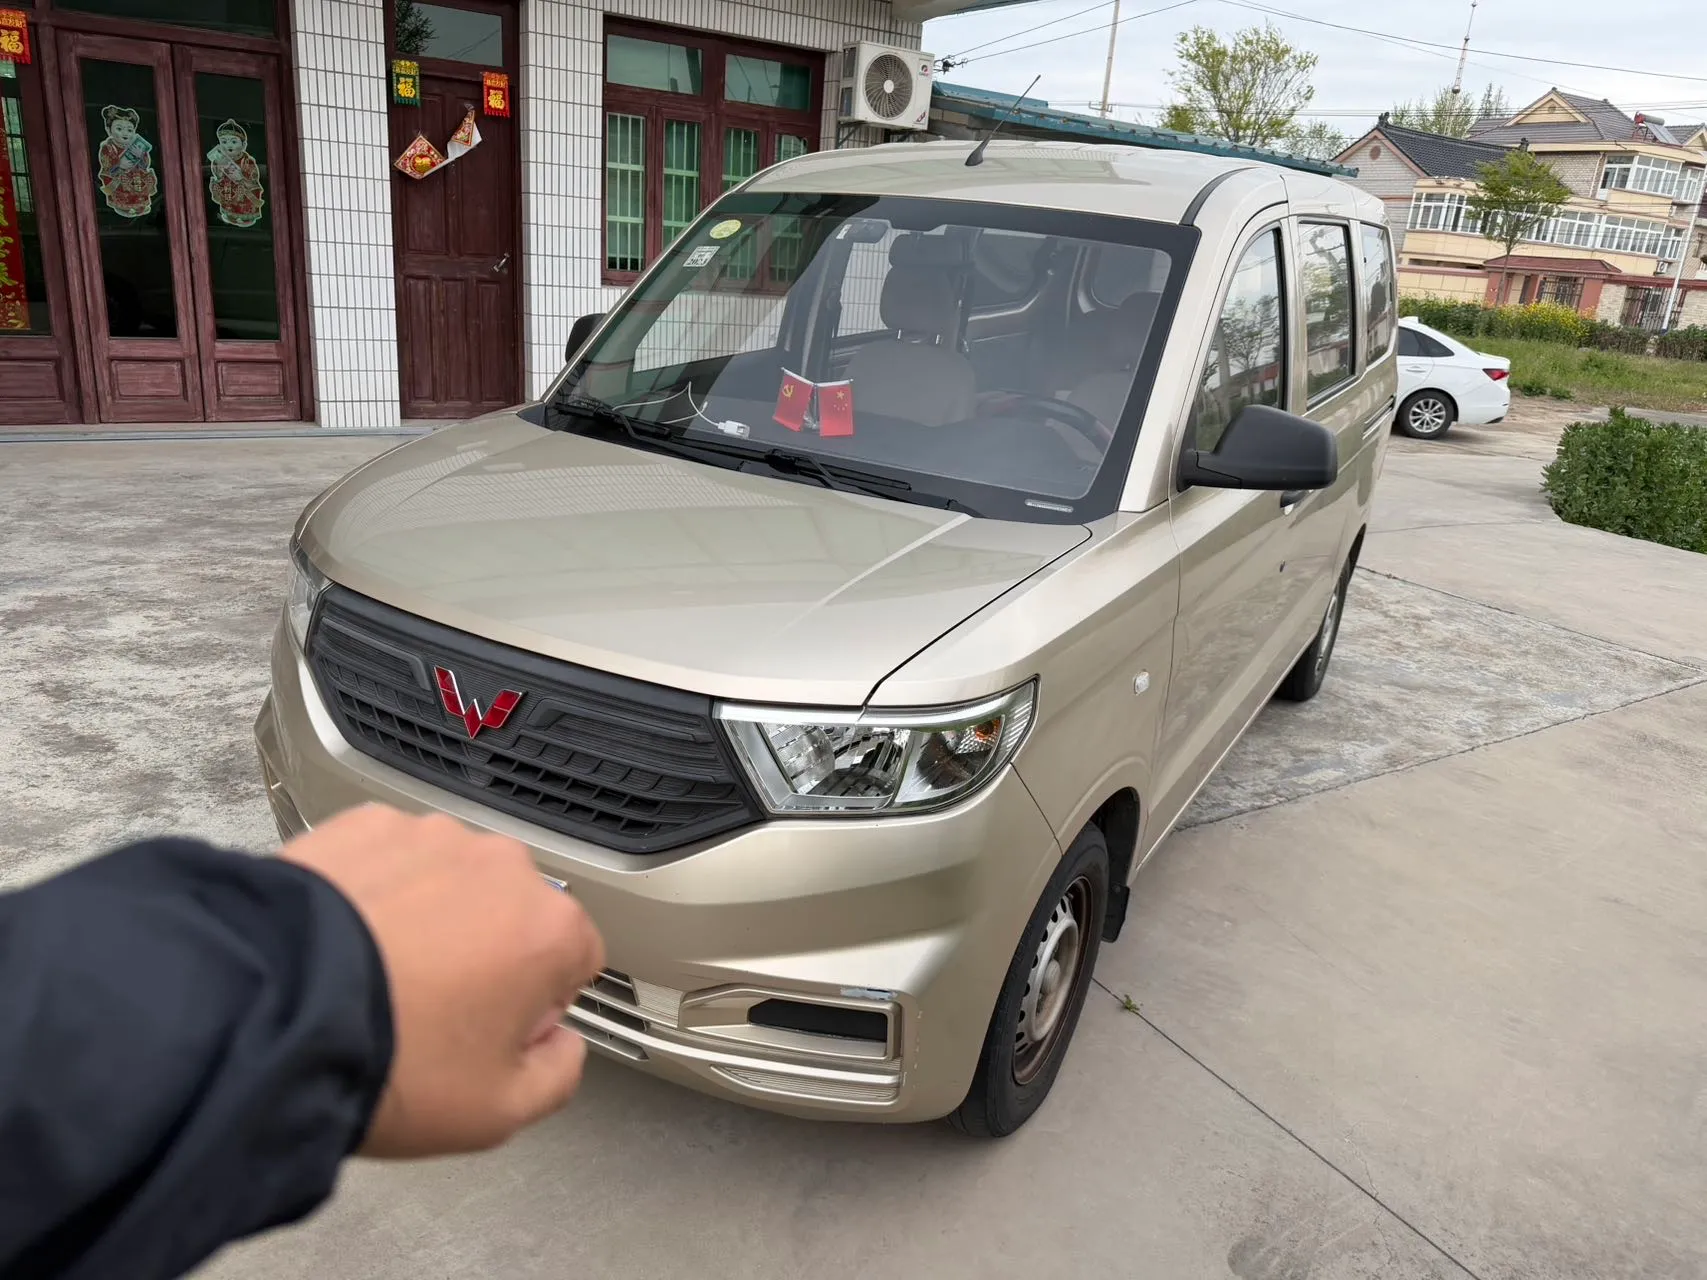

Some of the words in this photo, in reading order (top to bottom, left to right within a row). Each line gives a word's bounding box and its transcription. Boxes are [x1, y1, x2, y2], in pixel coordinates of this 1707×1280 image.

[0, 29, 24, 54] 福
[398, 77, 415, 98] 福
[488, 89, 505, 110] 福
